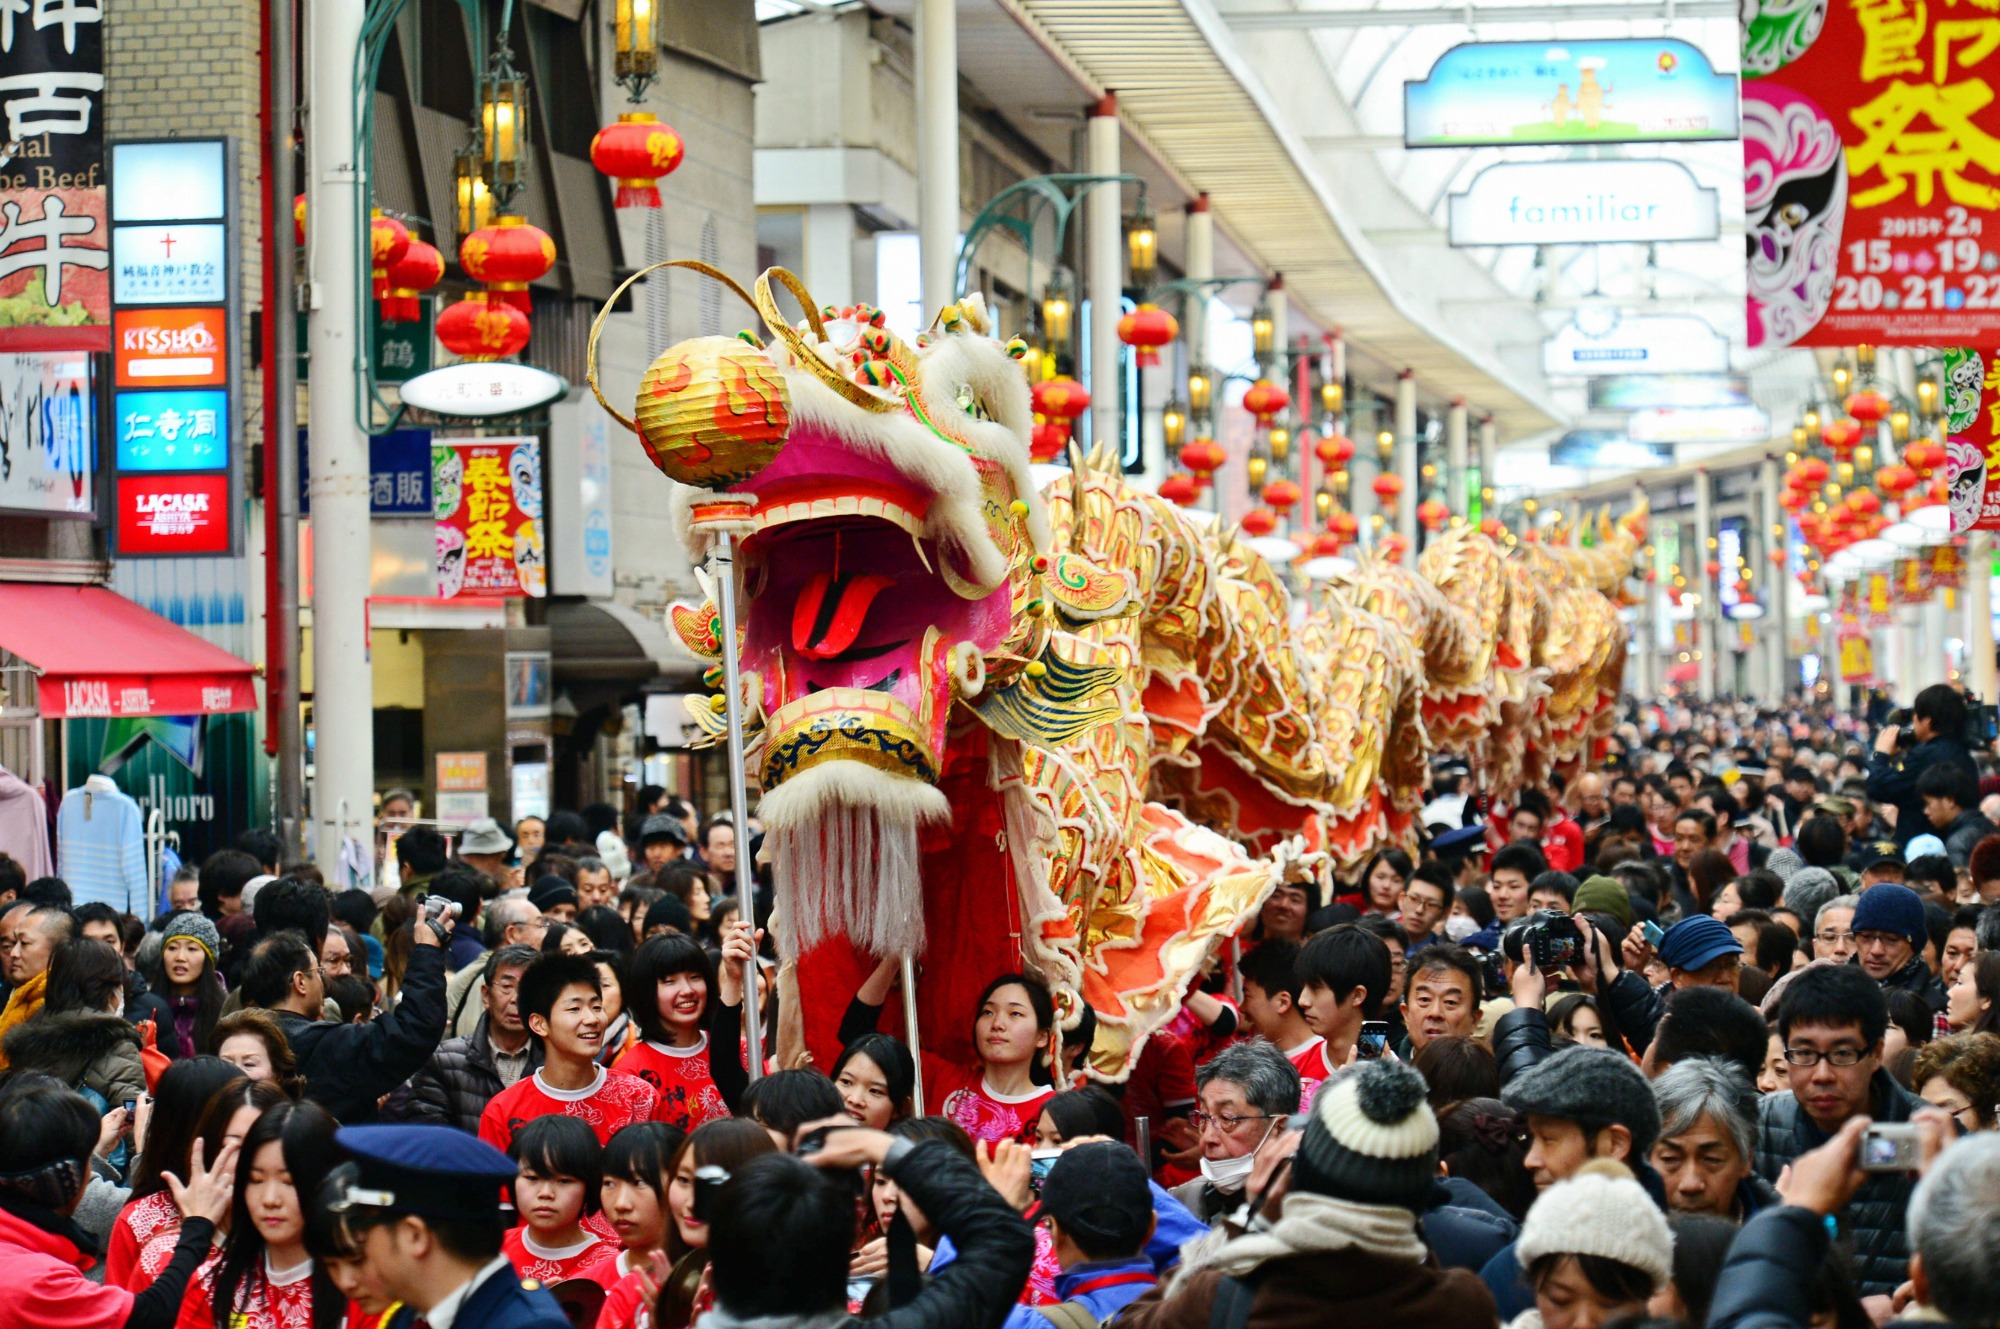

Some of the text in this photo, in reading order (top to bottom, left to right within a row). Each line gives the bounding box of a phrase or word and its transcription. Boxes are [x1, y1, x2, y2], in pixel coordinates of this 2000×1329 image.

[35, 162, 100, 192] Beef
[1509, 194, 1661, 224] familiar
[1847, 238, 1893, 273] 15
[1934, 238, 1981, 273] 19
[1834, 275, 1884, 310] 20
[1901, 275, 1946, 310] 21
[123, 327, 214, 350] KISSHO
[462, 456, 514, 559] 春節祭
[64, 680, 111, 716] LACASA
[139, 773, 215, 822] rlboro
